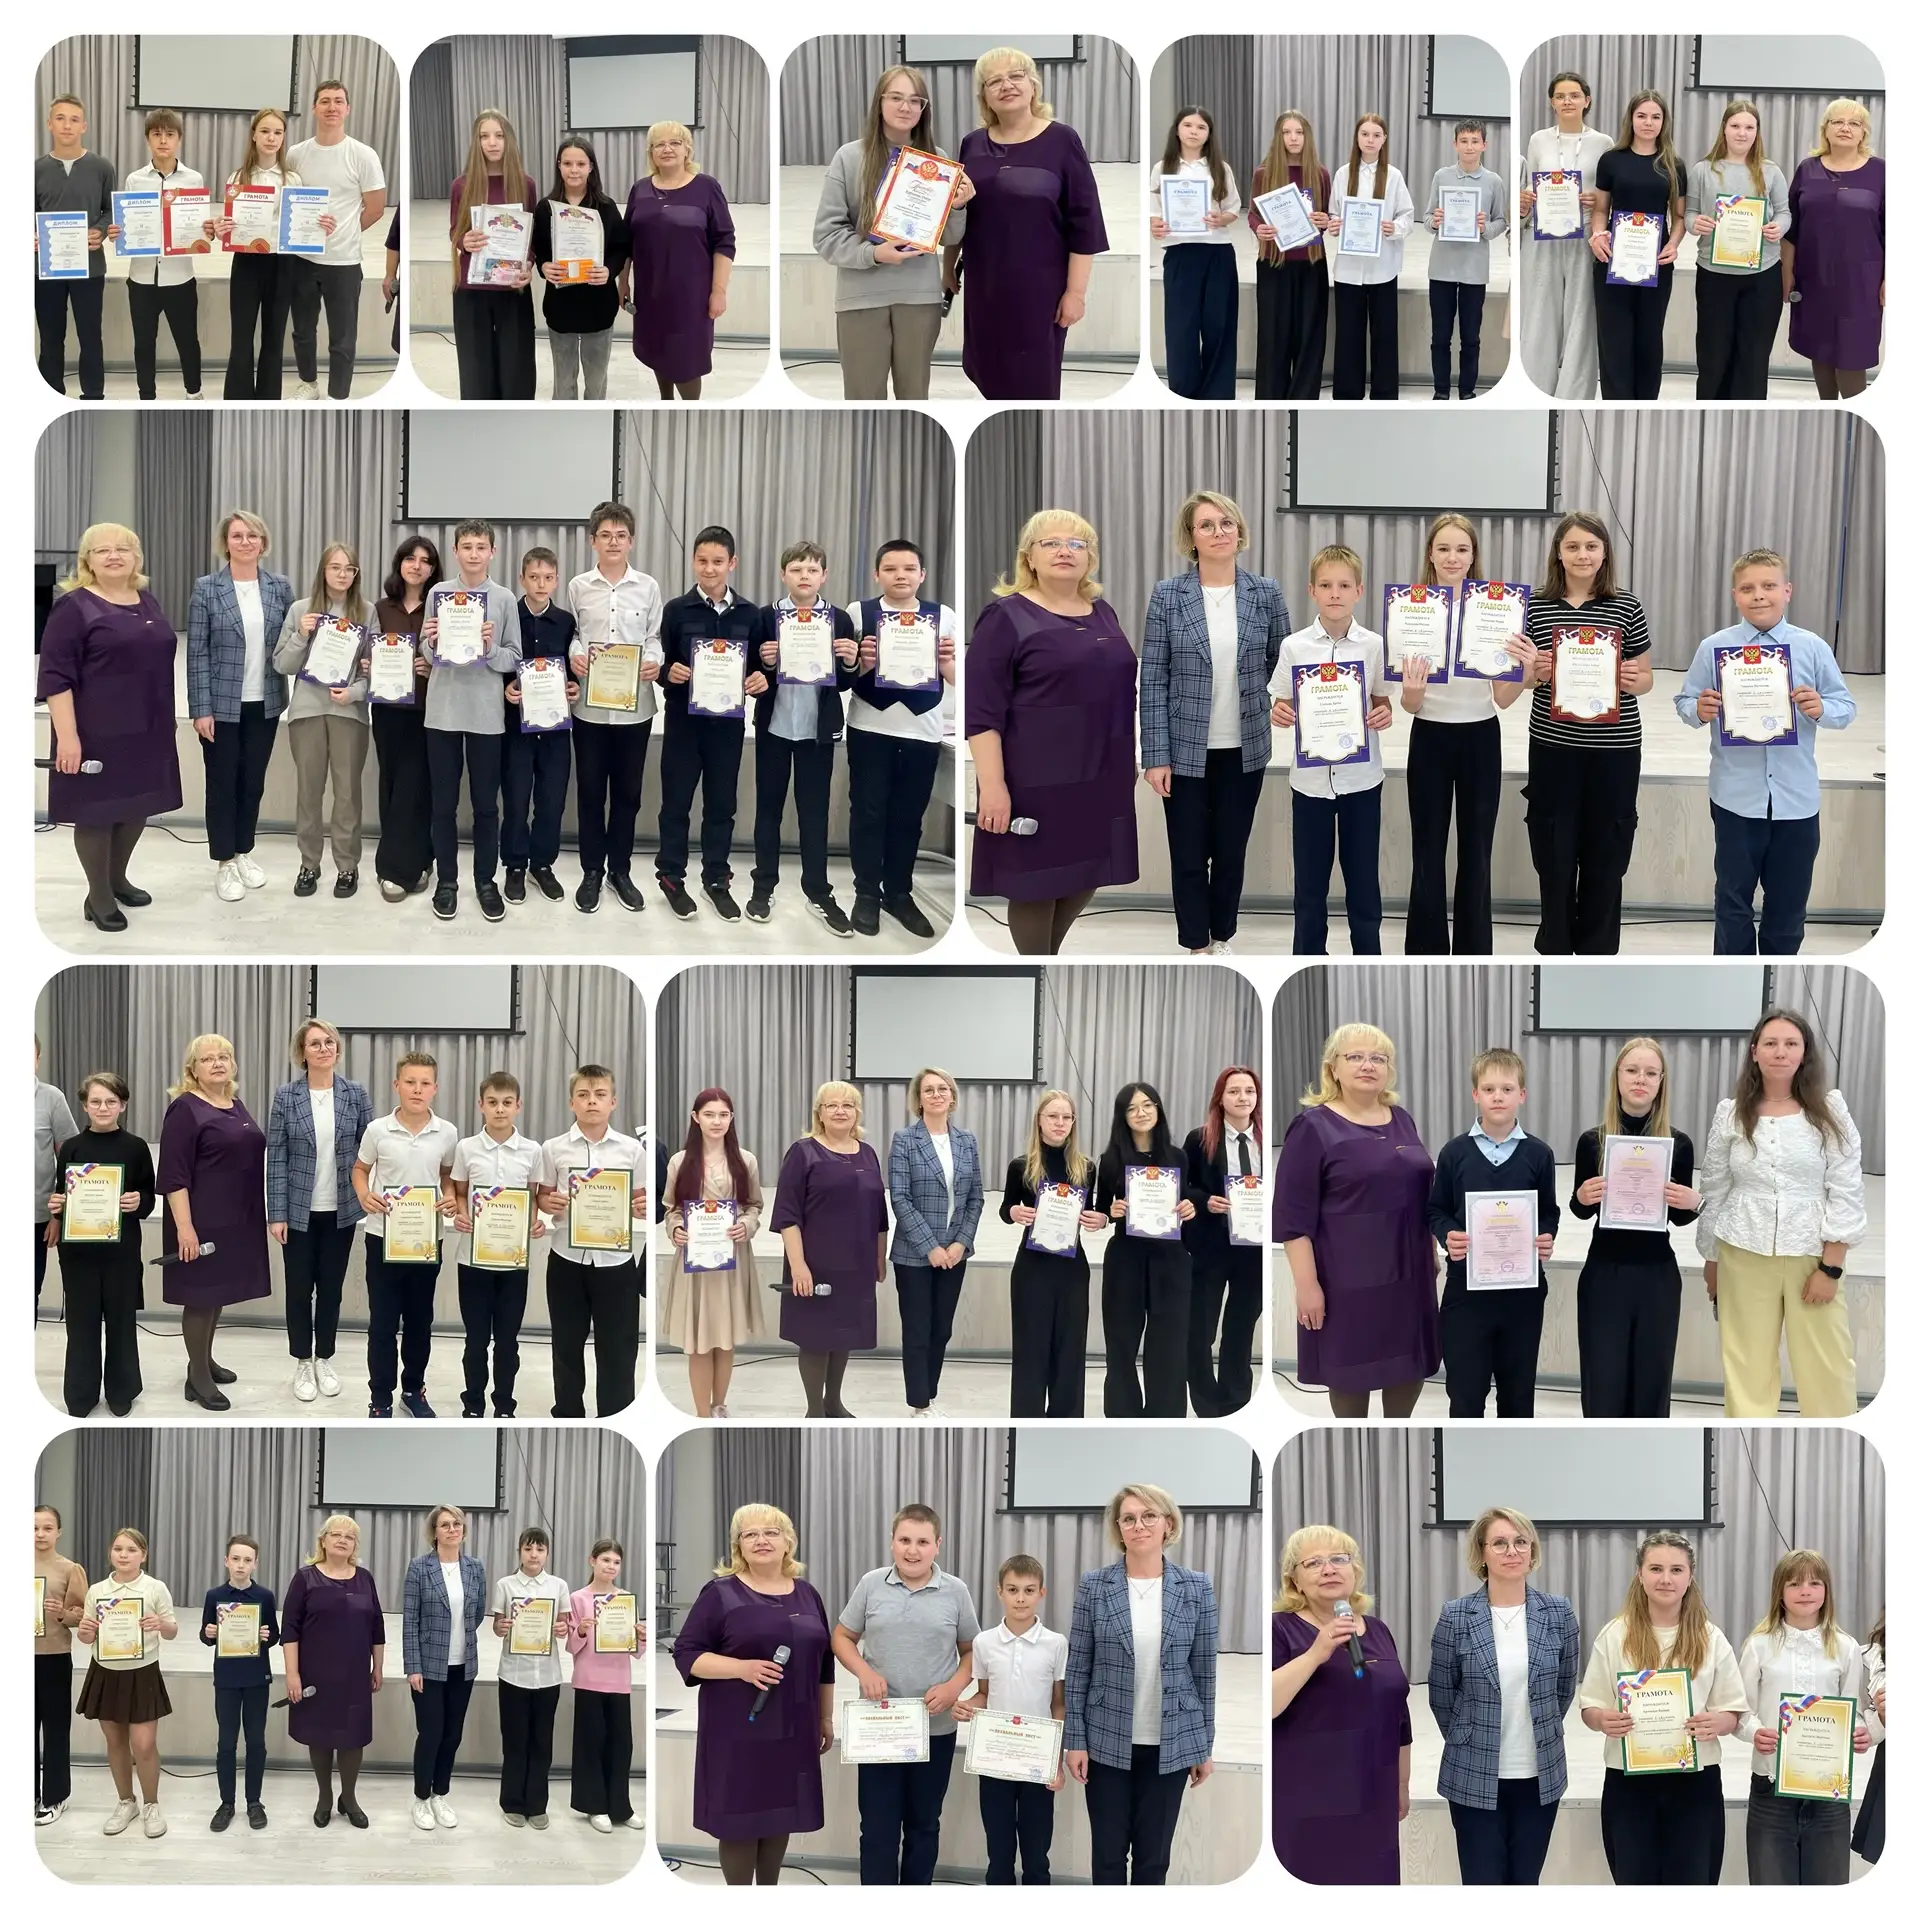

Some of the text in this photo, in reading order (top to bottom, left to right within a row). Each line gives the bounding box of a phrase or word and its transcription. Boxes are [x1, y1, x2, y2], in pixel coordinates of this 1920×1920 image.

[1727, 209, 1753, 217] ГРАМОТА
[1399, 605, 1436, 614] ГРАМОТА
[1476, 601, 1511, 612] ГРАМОТА
[326, 630, 351, 642] ГРАМОТА
[1568, 647, 1604, 655] ГРАМОТА
[1734, 667, 1773, 675] ГРАМОТА
[1311, 684, 1348, 694] ГРАМОТА
[1636, 1690, 1674, 1698] ГРАМОТА
[1798, 1715, 1836, 1724] ГРАМОТА
